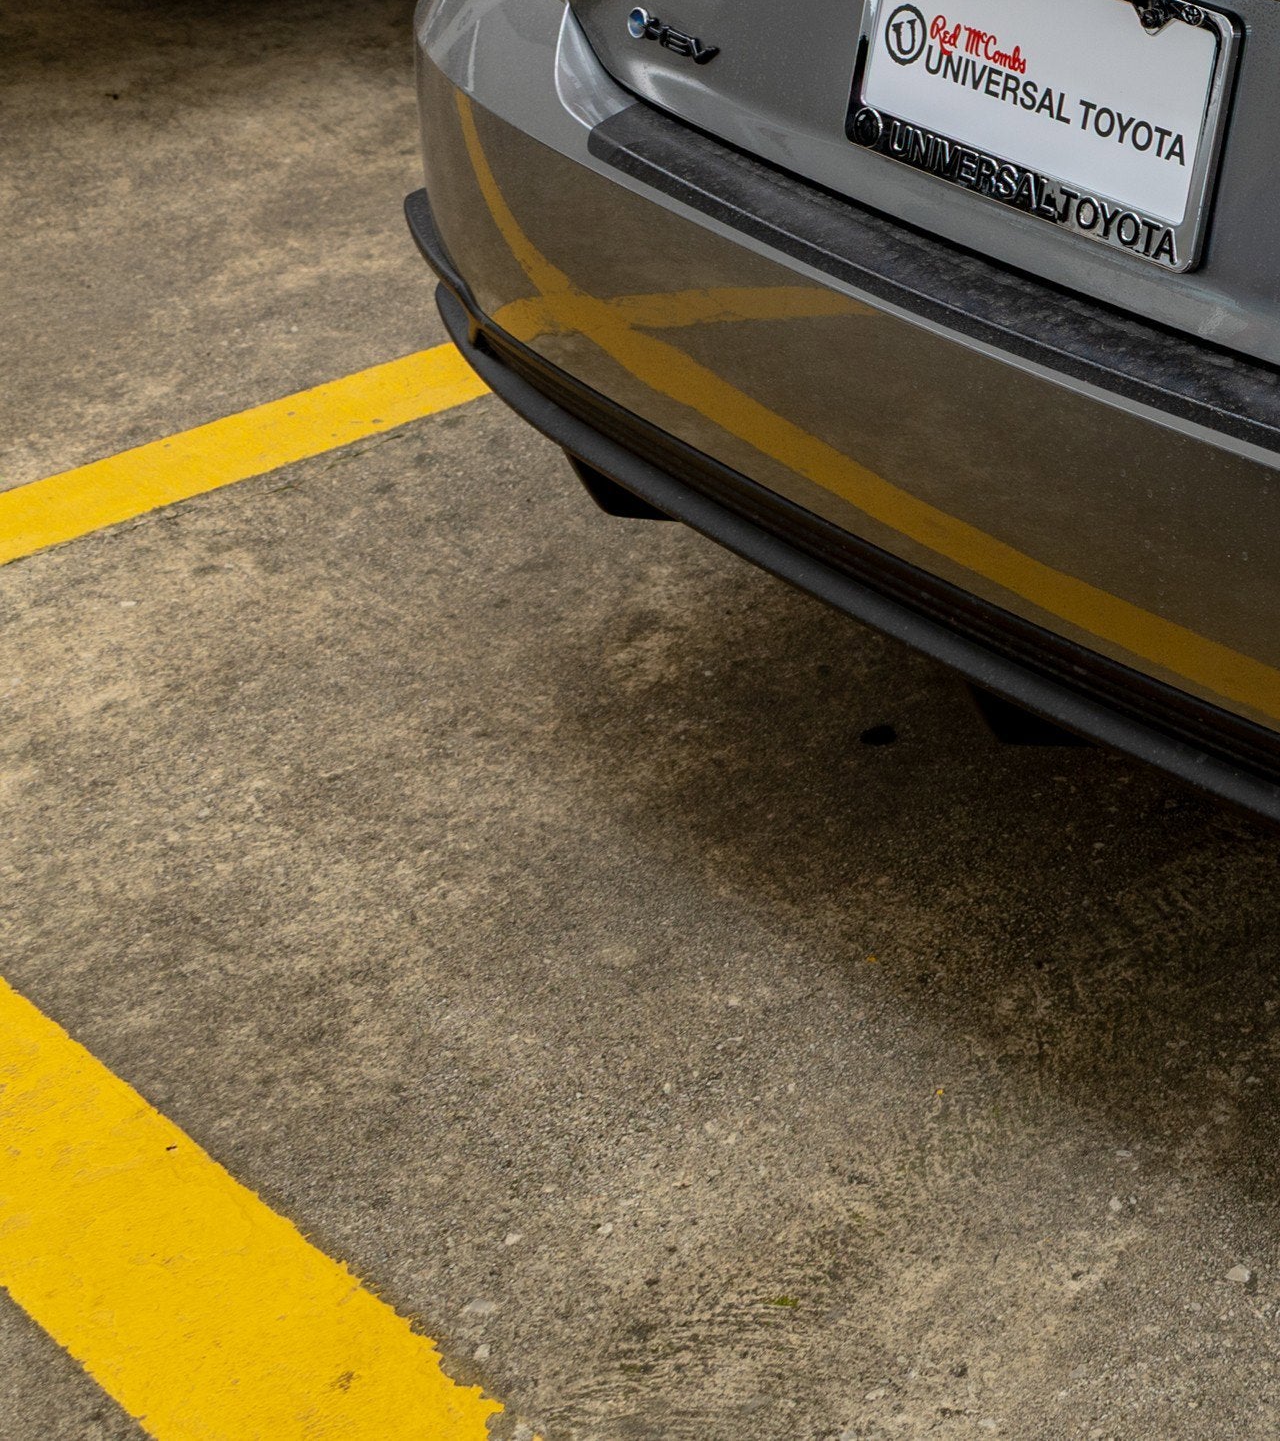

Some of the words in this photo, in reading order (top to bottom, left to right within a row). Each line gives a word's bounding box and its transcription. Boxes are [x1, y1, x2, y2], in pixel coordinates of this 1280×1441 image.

[925, 44, 1071, 125] UNIVERSAL
[1079, 99, 1186, 167] TOYOTA
[930, 14, 963, 56] Red
[964, 25, 1027, 75] McCombs
[889, 120, 1058, 219] UNIVERSAL
[1059, 185, 1179, 265] TOYOTA
